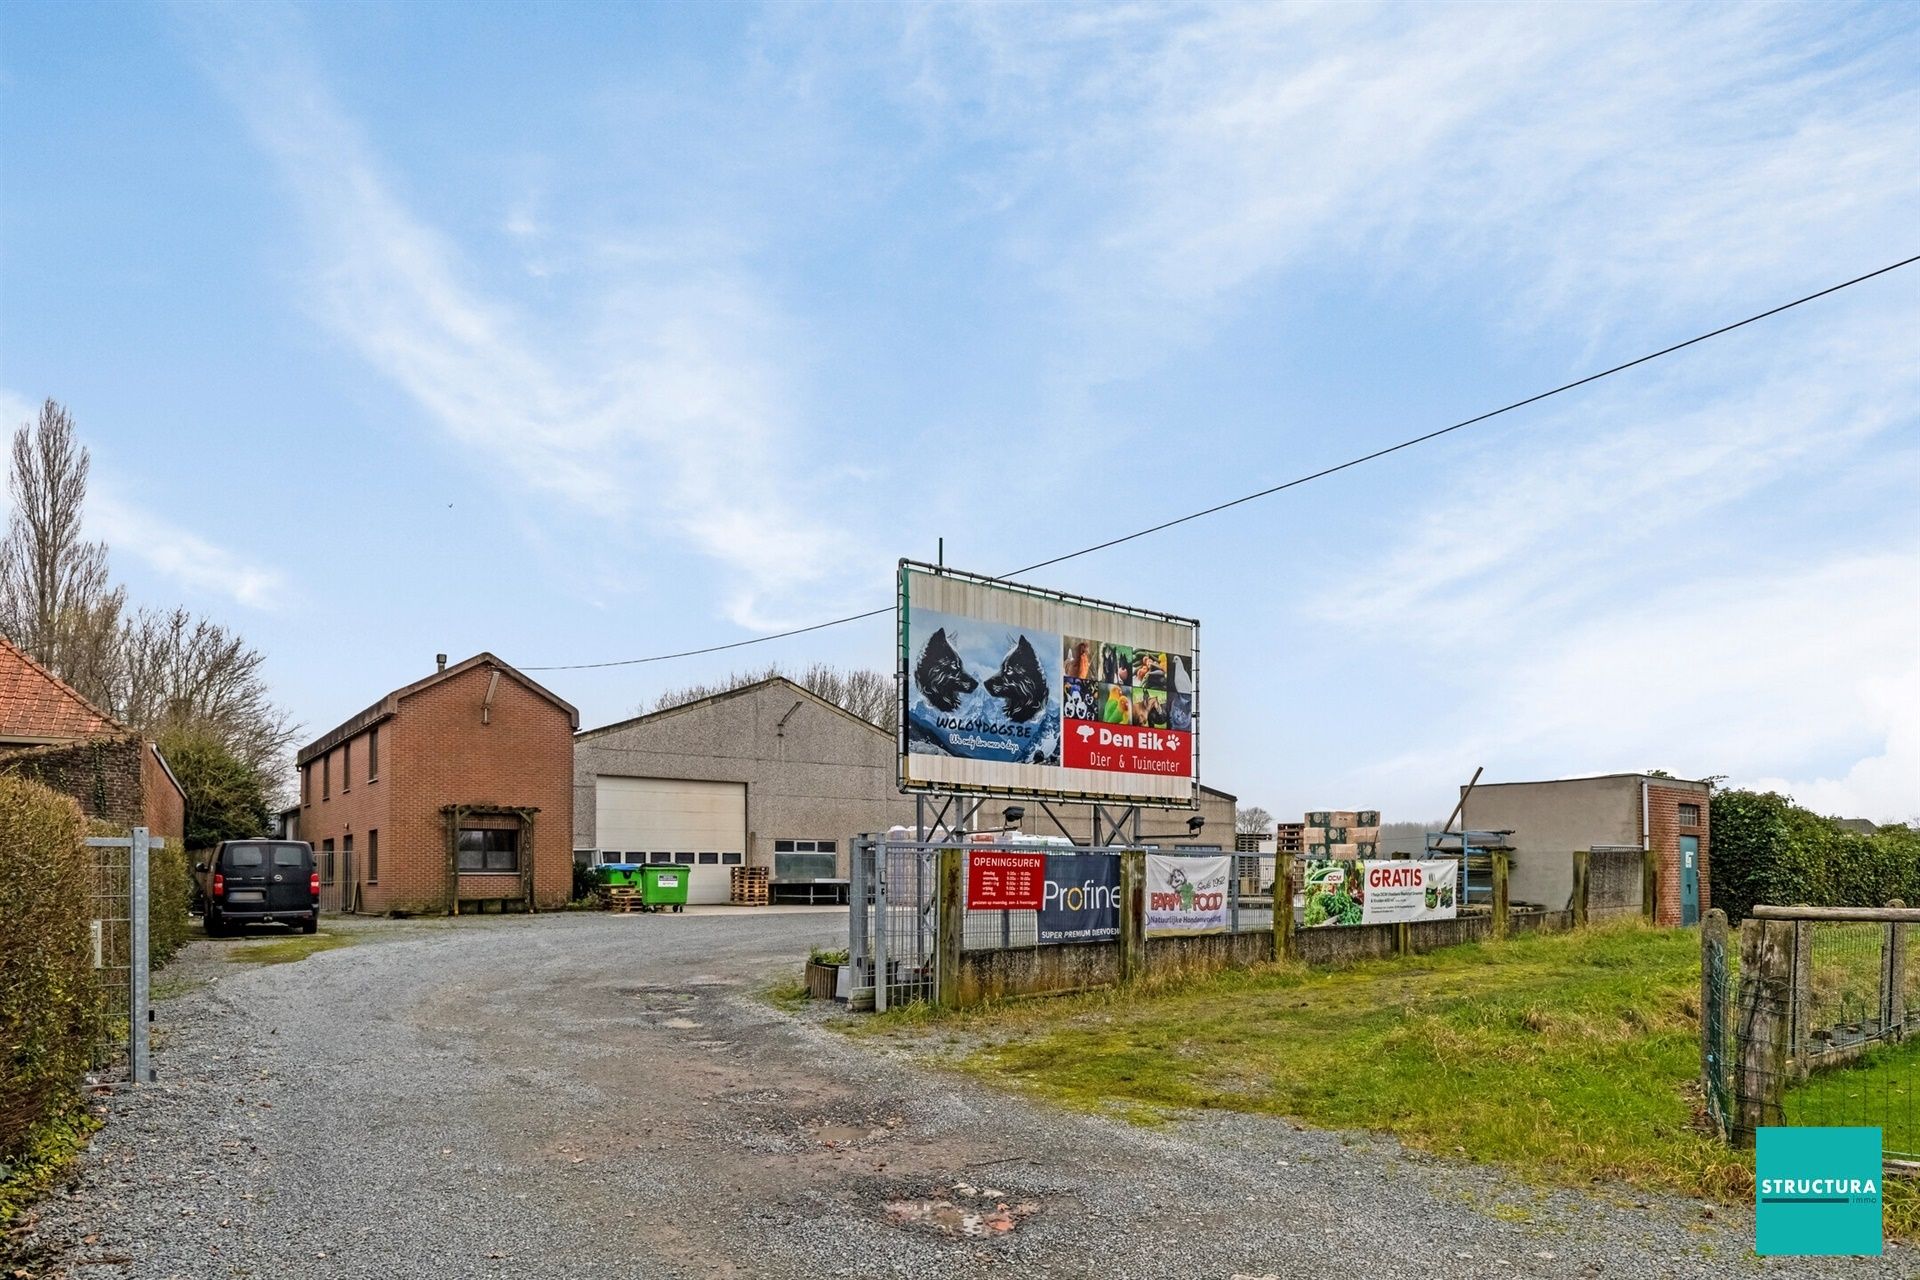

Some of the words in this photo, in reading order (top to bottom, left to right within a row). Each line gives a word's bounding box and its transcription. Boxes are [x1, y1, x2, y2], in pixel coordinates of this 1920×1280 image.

[1099, 728, 1134, 748] Den
[1138, 732, 1163, 751] Eik
[1090, 752, 1112, 767] Dier
[1118, 754, 1125, 768] &
[1132, 755, 1180, 772] Tuincenter
[973, 857, 1041, 868] OPENINGSUREN
[1370, 868, 1422, 888] GRATIS
[1042, 879, 1121, 911] Profine
[1150, 892, 1183, 911] FARM
[1192, 892, 1223, 911] FOOD
[1150, 915, 1182, 925] Natuurlijke
[1041, 930, 1063, 939] SUPER
[1063, 929, 1091, 938] PREMIUM
